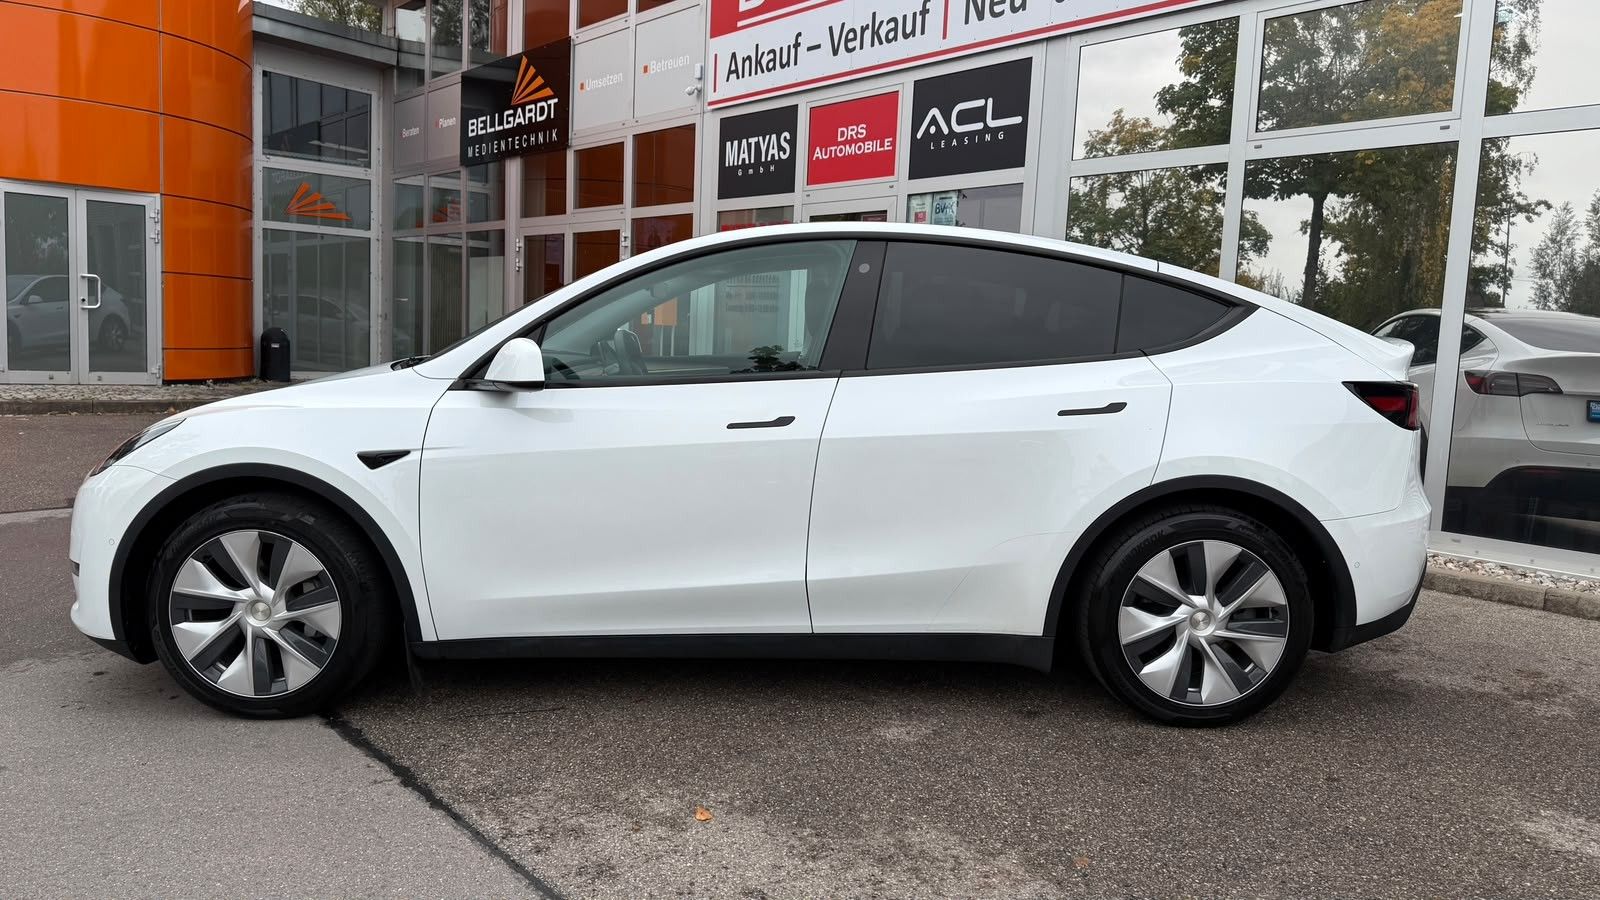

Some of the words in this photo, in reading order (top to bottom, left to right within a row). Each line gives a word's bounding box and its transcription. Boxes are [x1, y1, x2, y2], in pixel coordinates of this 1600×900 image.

[726, 32, 802, 82] Ankauf
[828, 0, 931, 57] Verkauf
[650, 54, 690, 74] Betreuen
[586, 72, 623, 91] Umsetzen
[468, 98, 559, 138] BELLGARDT
[916, 97, 1023, 139] ACL
[467, 128, 558, 158] MEDIENTECHNIK
[837, 123, 867, 142] DRS
[930, 131, 1004, 150] LEASING
[725, 131, 791, 168] MATYAS
[737, 164, 775, 176] GmbH
